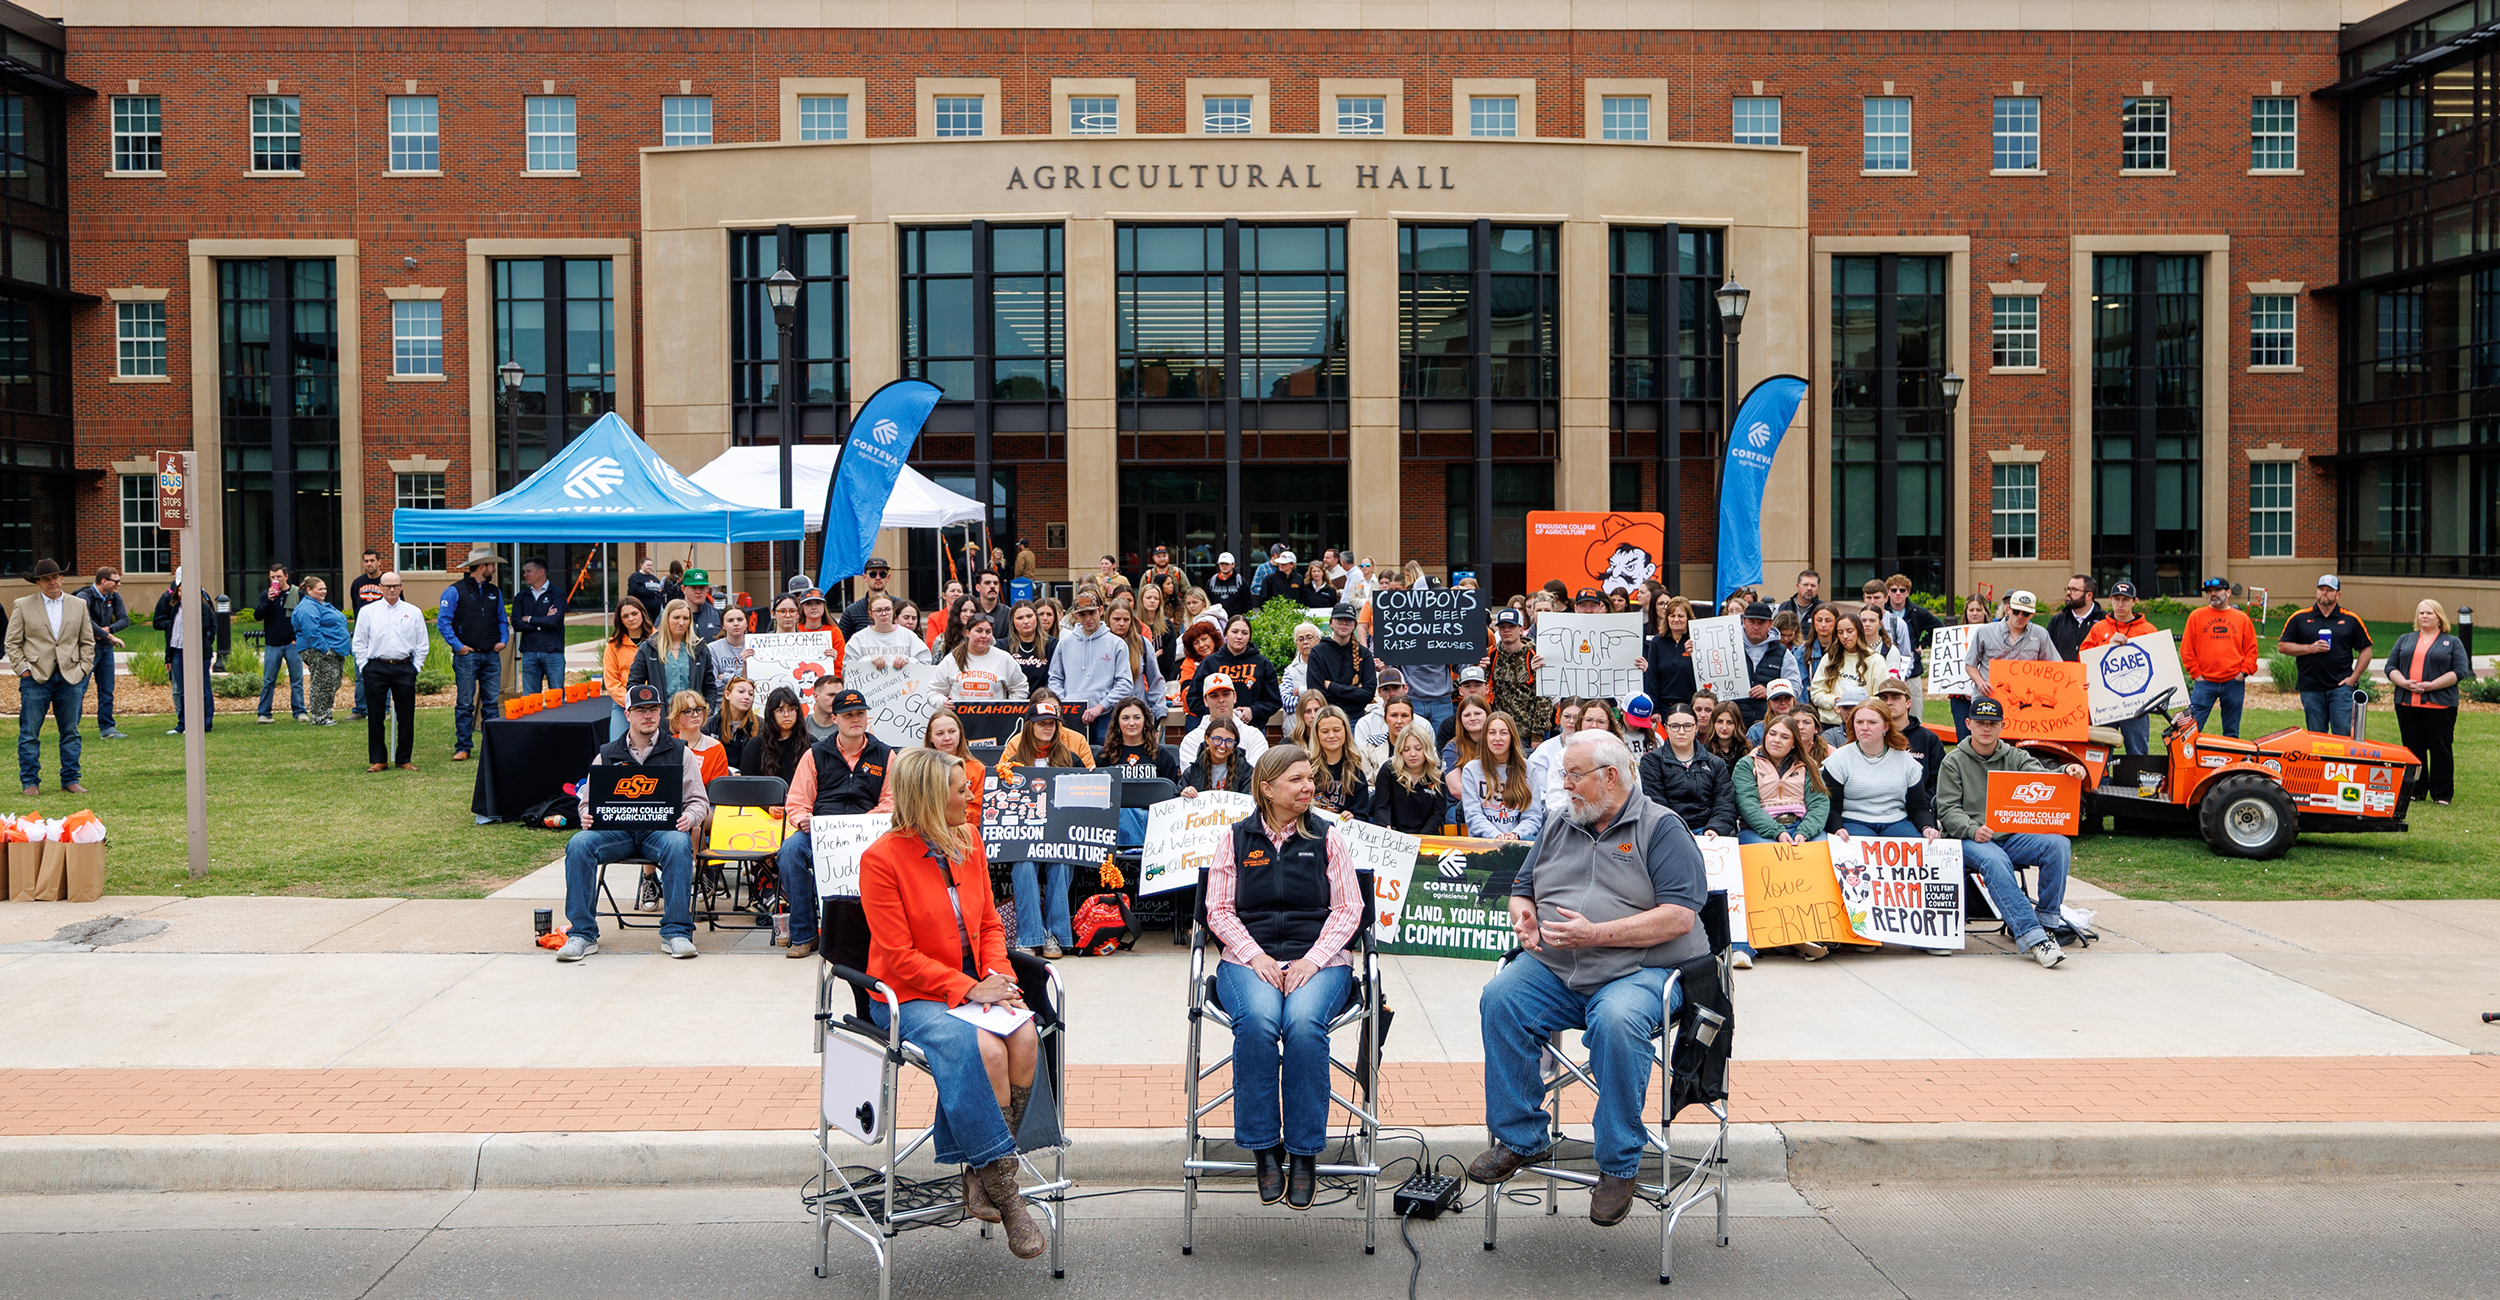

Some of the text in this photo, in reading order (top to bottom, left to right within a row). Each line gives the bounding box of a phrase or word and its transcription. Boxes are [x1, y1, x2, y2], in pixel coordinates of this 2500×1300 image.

[1006, 164, 1455, 189] AGRICULTURAL HALL
[852, 438, 898, 466] CORTEVA
[1731, 448, 1771, 465] CORTEVA
[161, 474, 182, 487] BUS
[162, 497, 182, 507] STOPS
[164, 509, 181, 519] HERE
[1376, 589, 1477, 611] COWBOYS
[1383, 610, 1467, 620] RAISE BEEF
[1383, 622, 1464, 638] SOONERS
[755, 633, 824, 648] WELCOME
[1383, 639, 1475, 651] RAISE EXCUSES
[1932, 660, 1964, 677] EAT
[2103, 652, 2146, 676] ASABE
[956, 670, 998, 684] FERGUSON
[1540, 665, 1586, 697] EAT
[2009, 661, 2078, 688] COWBOY
[2003, 704, 2086, 734] OTORSPORTS
[1120, 765, 1157, 779] RGUSON
[2324, 761, 2358, 783] CAT
[613, 774, 659, 799] OSU
[2011, 781, 2056, 804] OSU
[596, 806, 675, 814] FERGUSON COLLEGE
[1153, 792, 1248, 818] We May Not Be
[602, 813, 668, 821] OF AGRICULTURE
[1999, 816, 2064, 826] OF AGRICULTURE
[2036, 812, 2071, 820] COLLEGE
[982, 825, 1117, 846] FERGUSON COLLEGE
[1357, 823, 1380, 844] Your
[1381, 830, 1419, 856] Babies
[985, 843, 1108, 863] OF AGRICULTURE
[1143, 838, 1167, 858] But
[1365, 844, 1380, 864] To
[1381, 849, 1398, 869] Be
[1773, 845, 1804, 862] WE
[1875, 866, 1940, 881] I MADE
[1422, 881, 1479, 893] CORTEVA
[1760, 865, 1812, 901] love
[1925, 884, 1955, 892] LIVE FROM
[1432, 892, 1469, 901] agriscience
[1871, 880, 1922, 909] FARM
[1926, 892, 1954, 900] COWBOY
[1928, 900, 1957, 908] COUNTRY
[1405, 903, 1446, 924] LAND,
[1450, 907, 1486, 926] YOUR
[1871, 906, 1960, 937] REPORT!
